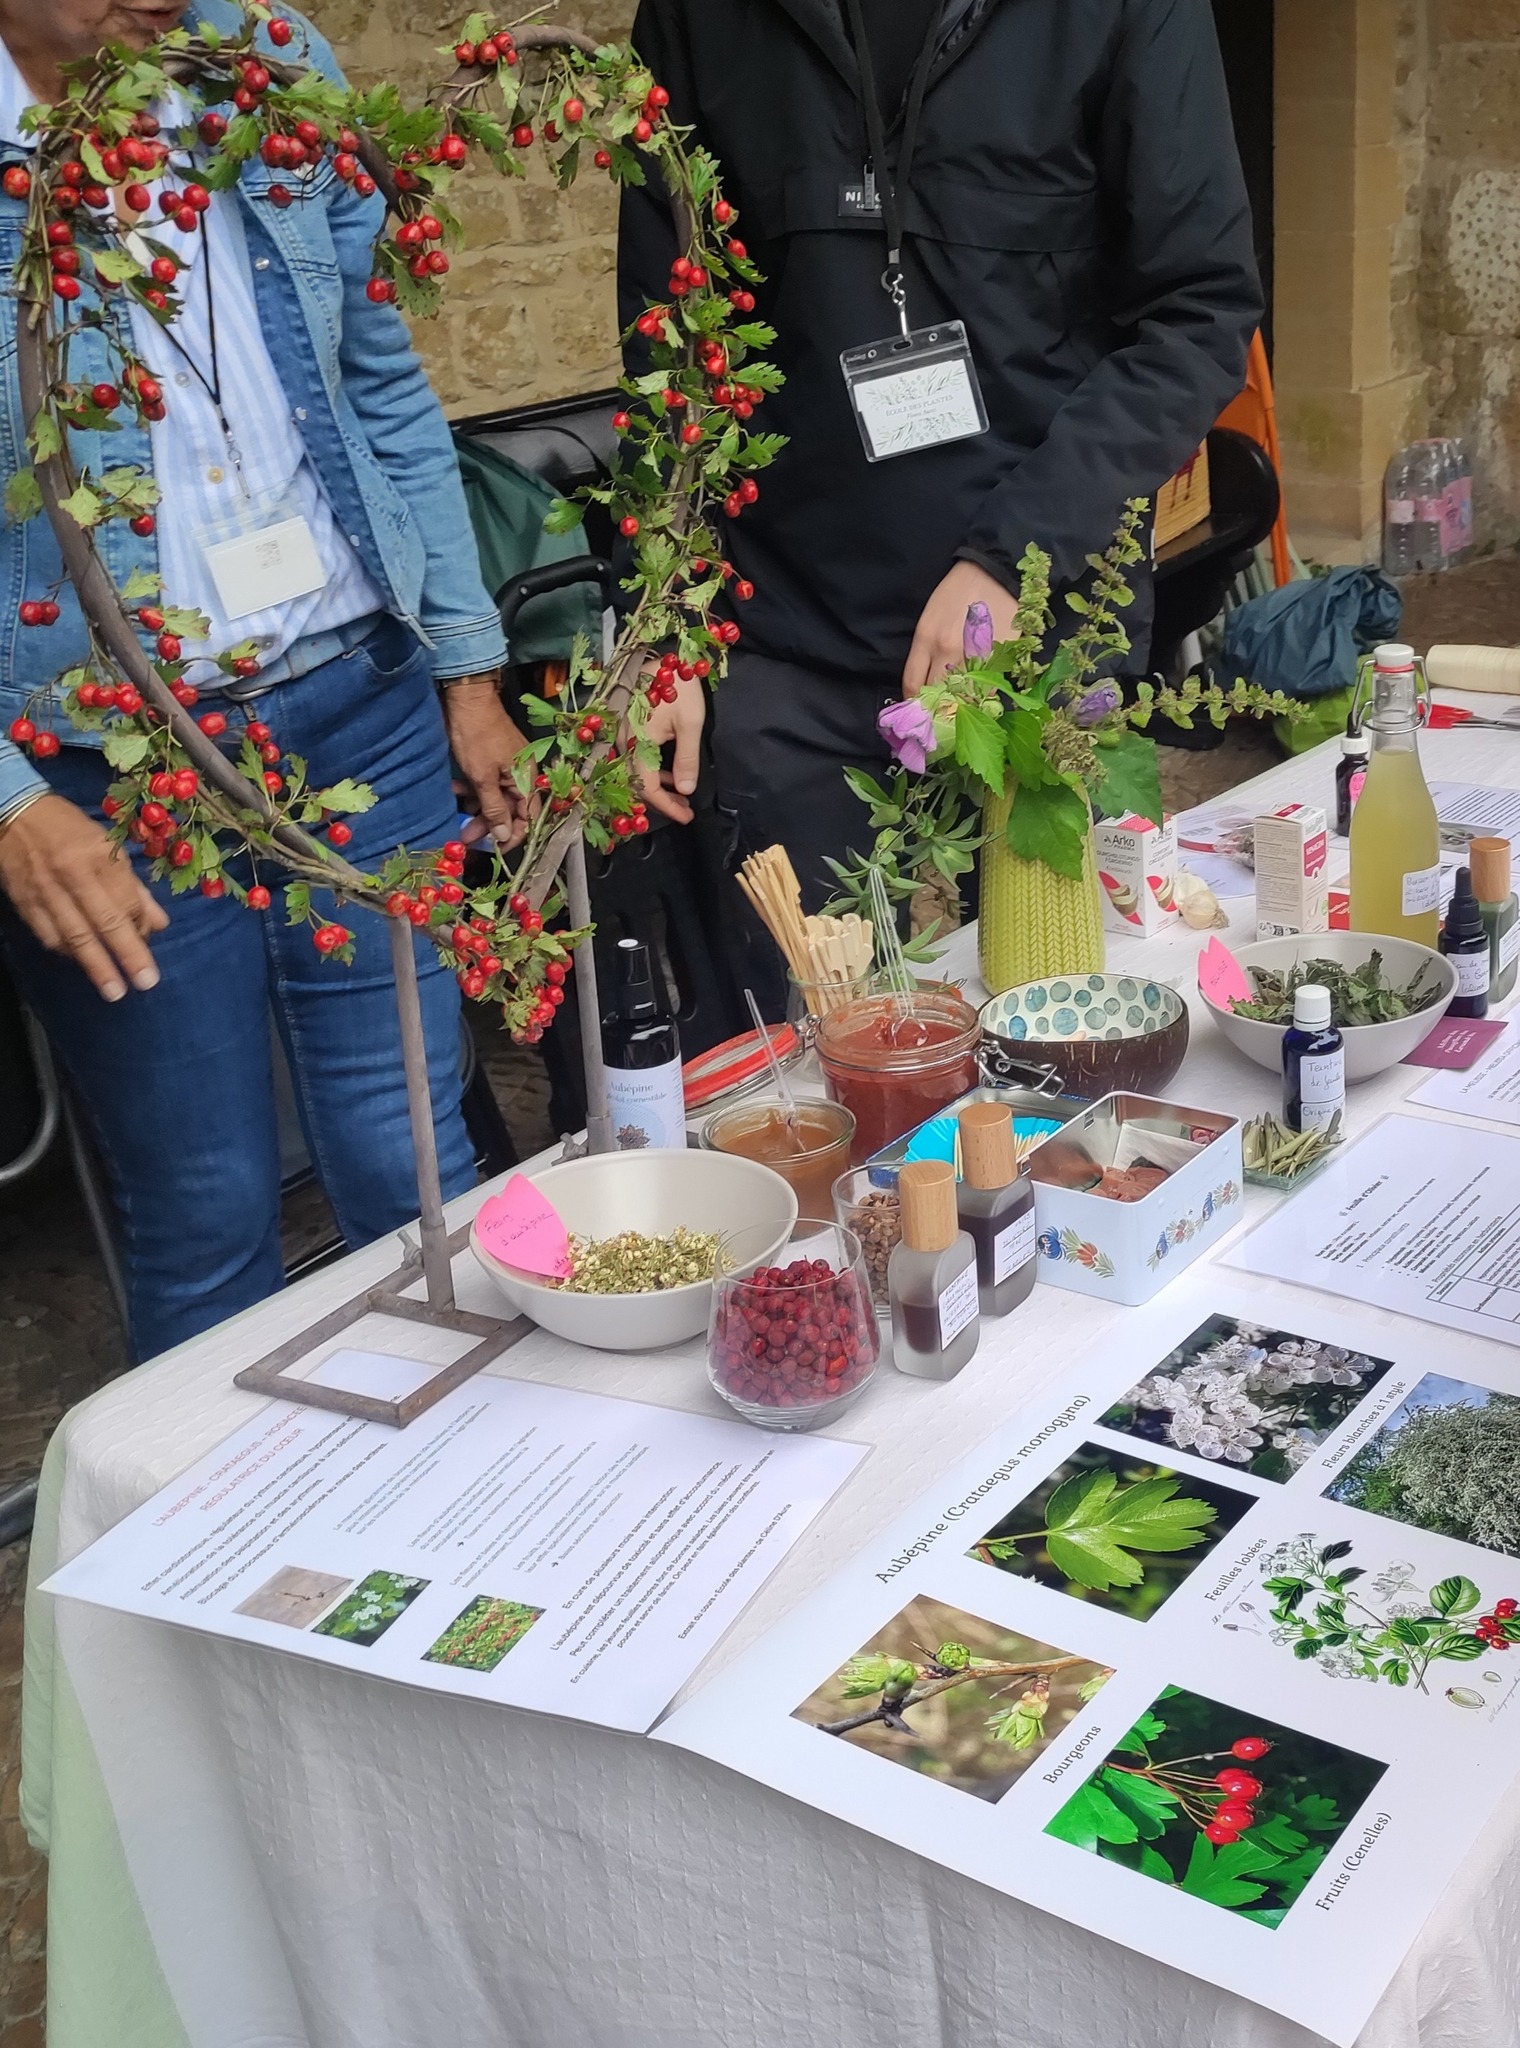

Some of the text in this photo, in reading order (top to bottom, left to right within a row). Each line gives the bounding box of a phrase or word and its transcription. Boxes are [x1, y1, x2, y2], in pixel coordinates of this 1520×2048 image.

[1112, 834, 1135, 847] Arko
[1322, 1444, 1350, 1469] Fleurs
[1344, 1411, 1380, 1448] blanches
[1387, 1381, 1406, 1401] style
[199, 1462, 263, 1510] REGULATRICE
[875, 1395, 1091, 1584] Aubépine (Crataegus monogyna)
[550, 1615, 586, 1650] L'aubépine
[583, 1603, 595, 1614] est
[592, 1570, 624, 1604] dépourvue
[627, 1539, 651, 1561] toxicité
[654, 1518, 670, 1532] sans
[666, 1504, 681, 1518] effet
[678, 1461, 723, 1505] d'accoutumance.
[569, 1640, 588, 1656] Peut
[584, 1606, 616, 1640] compléter
[620, 1565, 652, 1597] traitement
[648, 1528, 684, 1565] allopathique
[680, 1514, 696, 1528] avec
[692, 1494, 713, 1514] accord
[717, 1464, 742, 1487] médecin.
[571, 1585, 588, 1600] cure
[592, 1548, 621, 1577] plusieurs
[617, 1533, 634, 1548] mois
[631, 1519, 647, 1532] sans
[643, 1486, 677, 1518] interruption.
[1204, 1565, 1242, 1601] Feuilles
[1235, 1537, 1268, 1569] lobées
[677, 1621, 697, 1639] Extrait
[1042, 1725, 1102, 1785] Bourgeons
[1315, 1811, 1393, 1911] Fruits (Cenelles)
